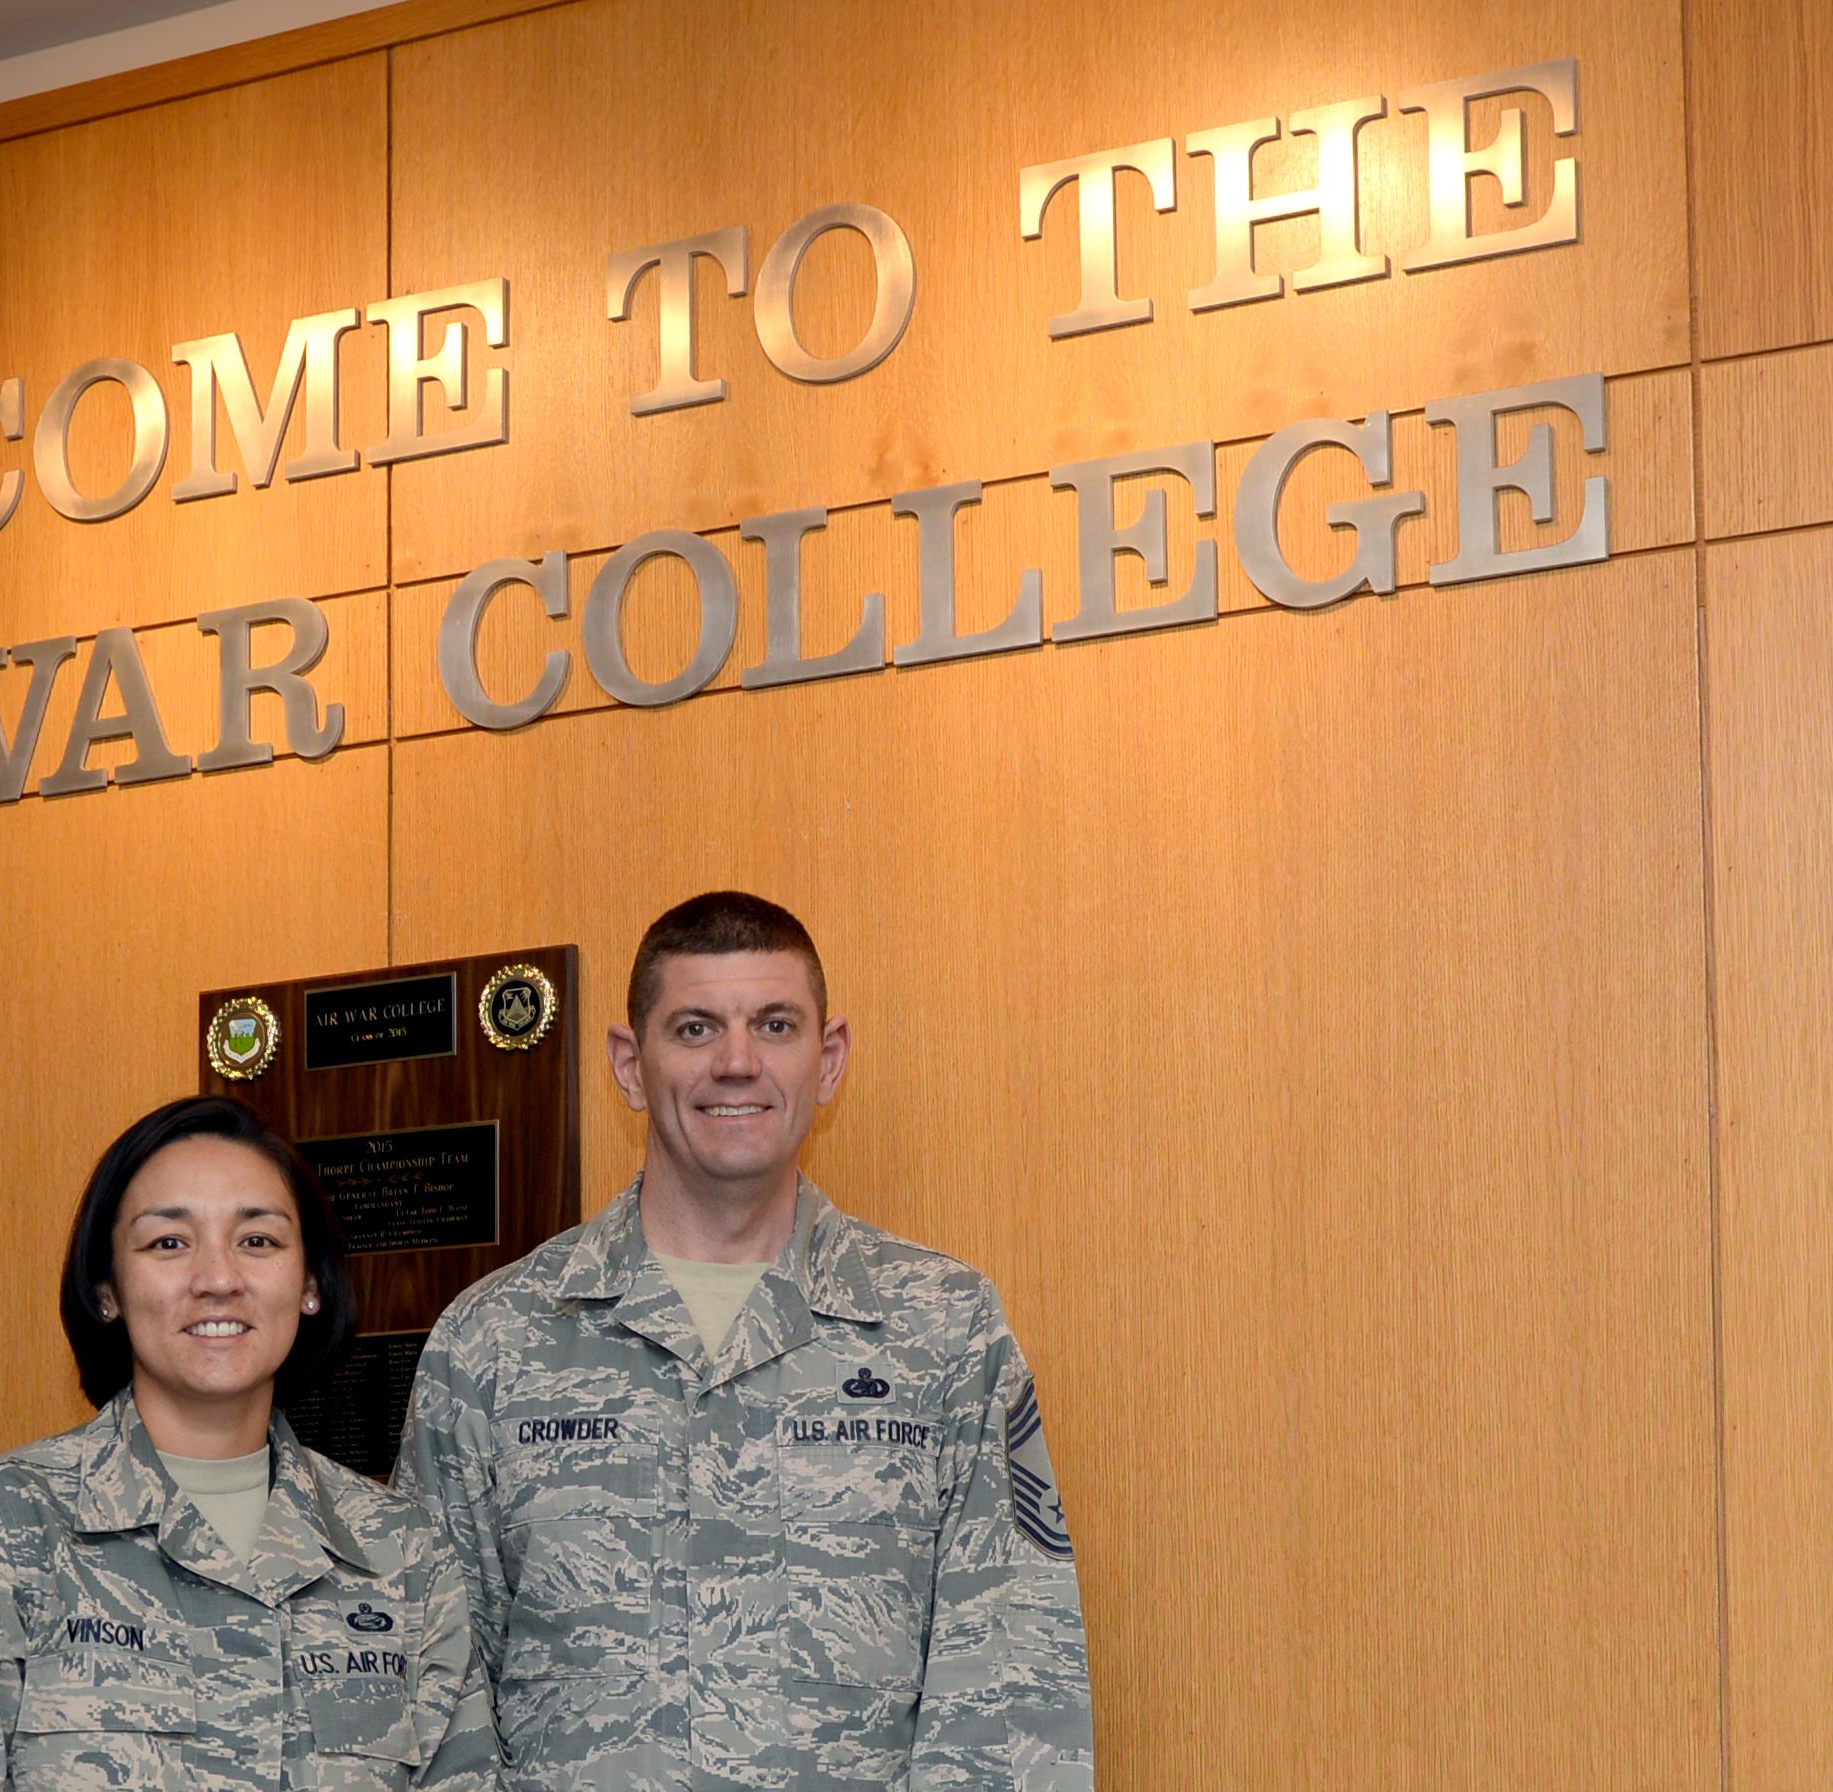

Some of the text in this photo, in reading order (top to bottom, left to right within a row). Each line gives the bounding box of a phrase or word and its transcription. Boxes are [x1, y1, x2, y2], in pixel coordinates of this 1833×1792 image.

[606, 203, 917, 416] TO
[1018, 56, 1580, 340] THE
[437, 371, 1610, 731] COLLEGE
[314, 998, 447, 1028] AIR WAR COLLEGE
[366, 1139, 393, 1154] 2015
[317, 1152, 469, 1178] THORPE CHAMPIONSHIP TEAM
[518, 1417, 620, 1445] CROWDER
[792, 1419, 930, 1449] U.S. AIR FORCE
[66, 1618, 145, 1651] VINSON
[300, 1652, 340, 1675] U.S.
[346, 1650, 380, 1674] AIR
